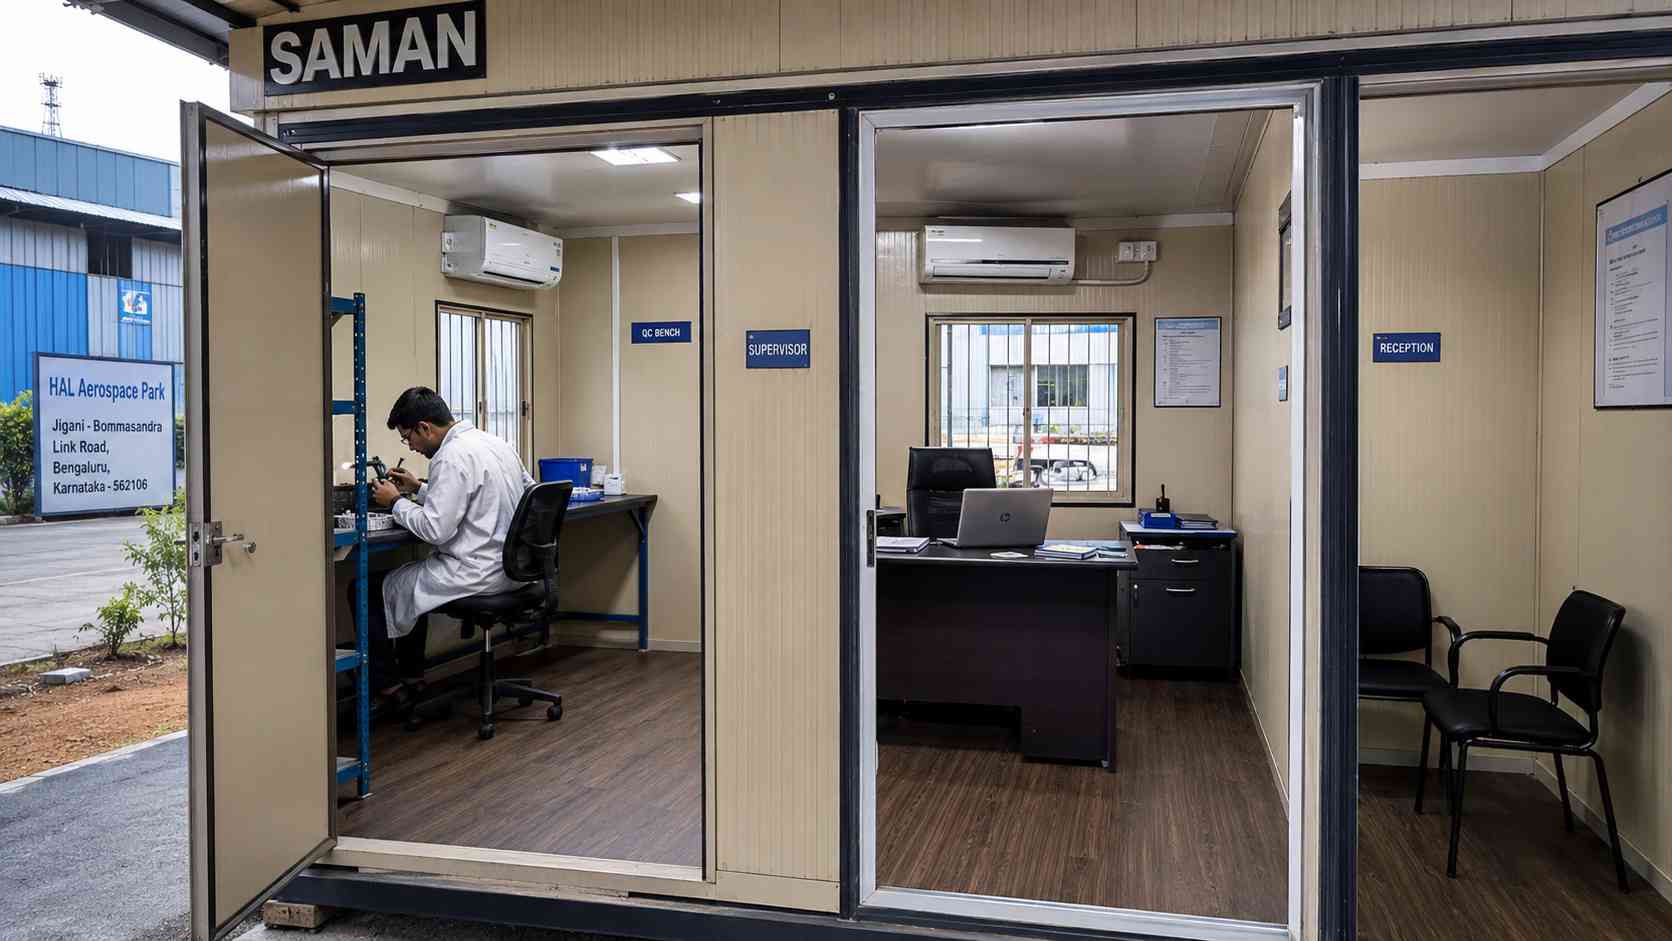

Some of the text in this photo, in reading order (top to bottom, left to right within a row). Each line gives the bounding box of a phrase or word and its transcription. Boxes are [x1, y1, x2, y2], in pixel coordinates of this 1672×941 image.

[270, 10, 476, 85] SAMAN
[642, 328, 680, 338] QC BENCH
[748, 343, 808, 356] SUPERVISOR
[1380, 342, 1434, 353] RECEPTION
[49, 376, 165, 402] HAL Aerospace Park
[52, 418, 85, 435] Jigani
[94, 420, 162, 432] Bommasandra
[53, 440, 110, 454] Link Road,
[53, 461, 110, 476] Bengaluru,
[53, 480, 106, 494] Karnataka
[113, 478, 148, 492] 562106
